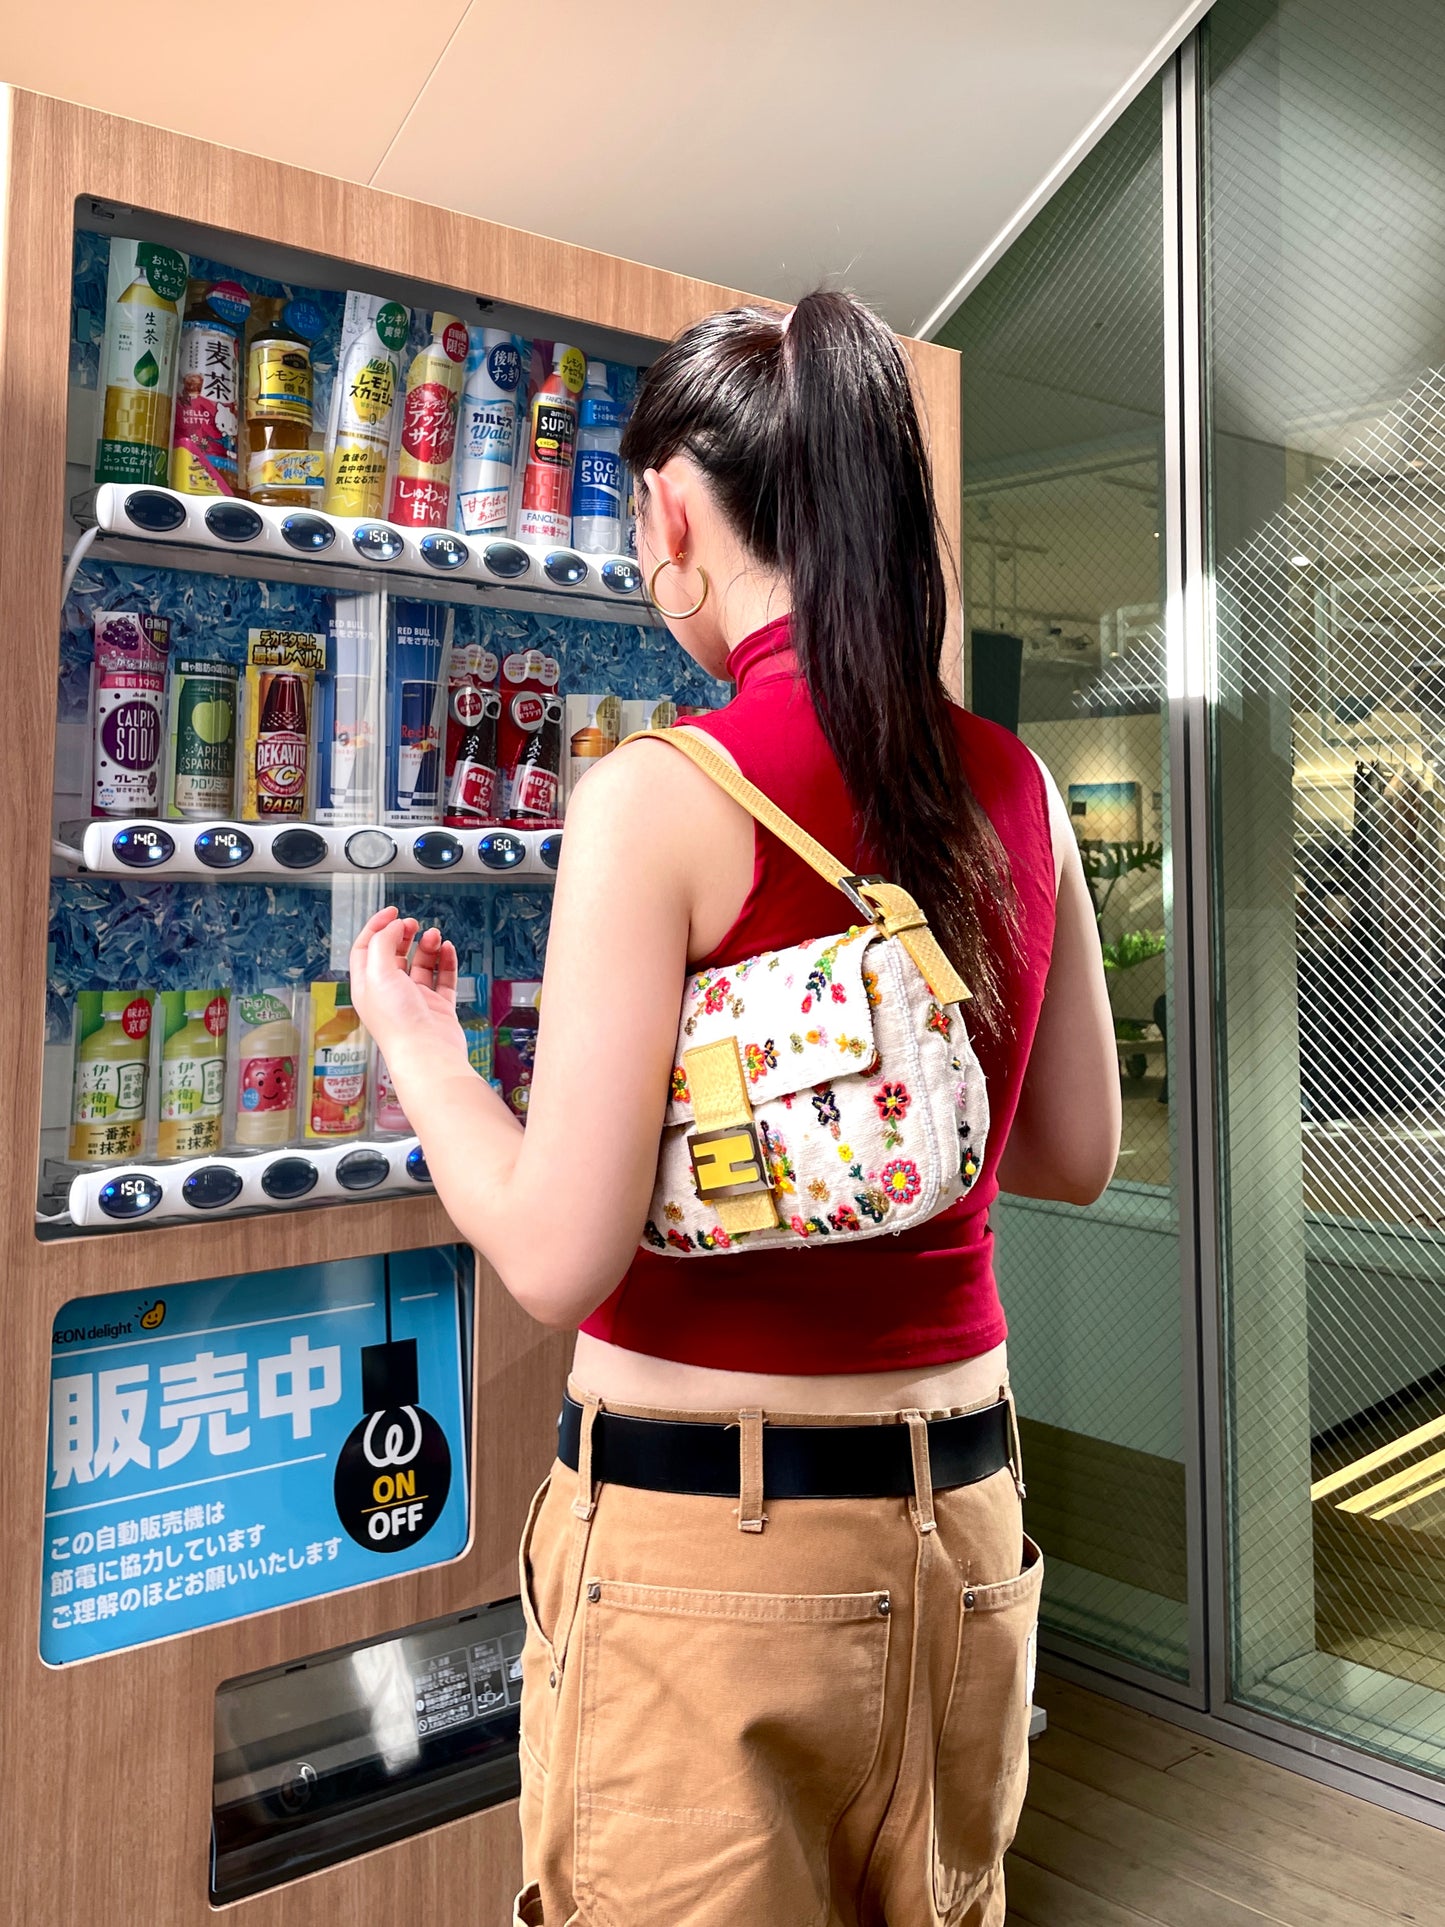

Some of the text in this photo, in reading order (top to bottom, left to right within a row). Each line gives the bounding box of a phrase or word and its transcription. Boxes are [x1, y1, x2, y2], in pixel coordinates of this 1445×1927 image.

[153, 268, 184, 287] ぎゅっと
[157, 285, 179, 297] 555ml
[377, 312, 408, 326] スッキリ
[143, 311, 160, 345] 生茶
[445, 338, 466, 358] 限定
[494, 350, 518, 366] 後味
[204, 341, 232, 401] 麦茶
[492, 367, 519, 384] すっきり
[358, 374, 391, 391] レモン
[183, 409, 210, 418] HELLO
[183, 417, 210, 426] KITTY
[408, 409, 456, 428] アップル
[472, 412, 513, 429] カルピス
[470, 425, 513, 441] Water
[341, 453, 368, 463] 食後の
[399, 480, 448, 506] しゅわっと
[410, 500, 441, 520] 甘い
[369, 530, 389, 543] 150
[435, 540, 455, 553] 170
[614, 565, 631, 577] 180
[328, 619, 364, 630] RED BULL
[397, 626, 431, 637] RED BULL
[260, 631, 316, 650] デカビタ史上
[116, 708, 156, 727] CALPIS
[401, 725, 426, 740] Red
[116, 727, 155, 761] SODA
[114, 774, 148, 784] グレープ
[275, 765, 297, 787] C
[133, 832, 157, 847] 140
[215, 834, 238, 848] 140
[493, 839, 512, 852] 150
[128, 1019, 149, 1034] 京都
[91, 1064, 112, 1120] 伊右衛門
[175, 1062, 196, 1115] 伊右衛門
[120, 1179, 146, 1196] 150
[87, 1322, 133, 1341] delight
[51, 1335, 343, 1491] 販売中
[372, 1469, 416, 1504] ON
[367, 1502, 424, 1541] OFF
[51, 1501, 226, 1561] この自動販売機は
[50, 1523, 267, 1598] 節電に協力しています
[51, 1536, 344, 1630] ご理解のほどお願いいたします
